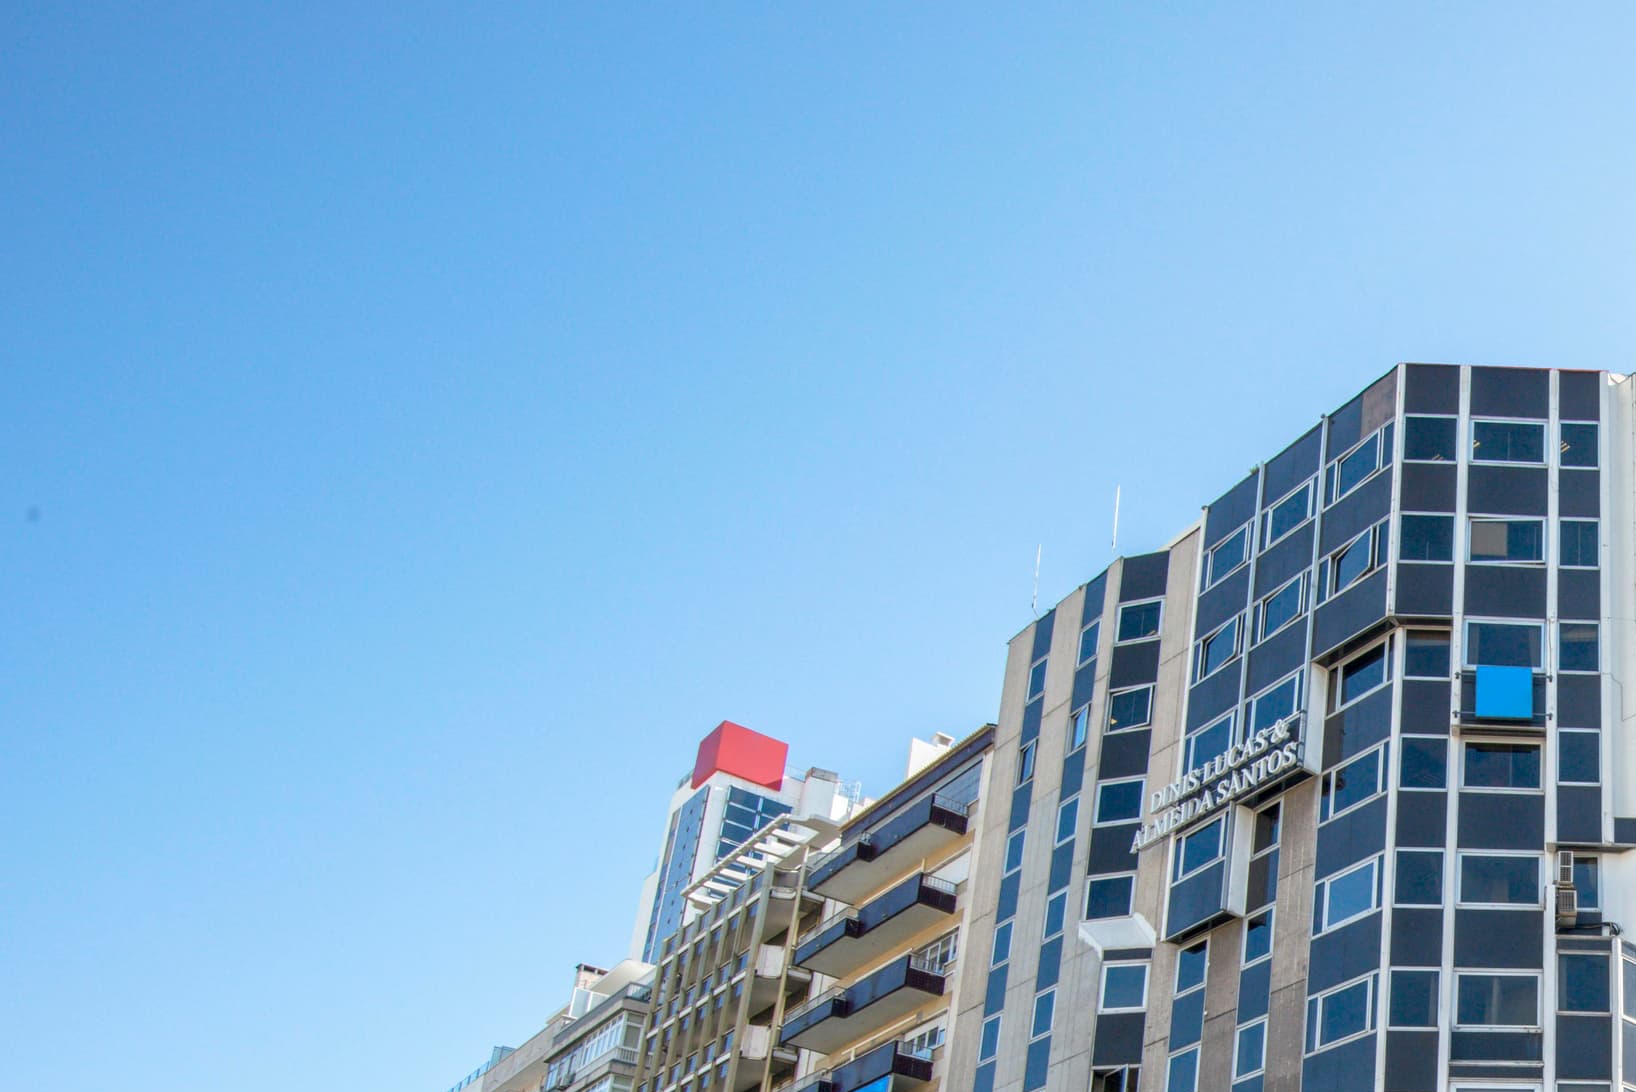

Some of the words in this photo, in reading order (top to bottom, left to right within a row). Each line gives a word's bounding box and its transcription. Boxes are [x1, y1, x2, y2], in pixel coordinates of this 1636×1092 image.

[1129, 790, 1215, 854] ALMEIDA
[1216, 740, 1299, 805] SANTOS
[1150, 768, 1200, 815] DINIS
[1202, 728, 1269, 784] LUCAS
[1271, 718, 1290, 745] &
